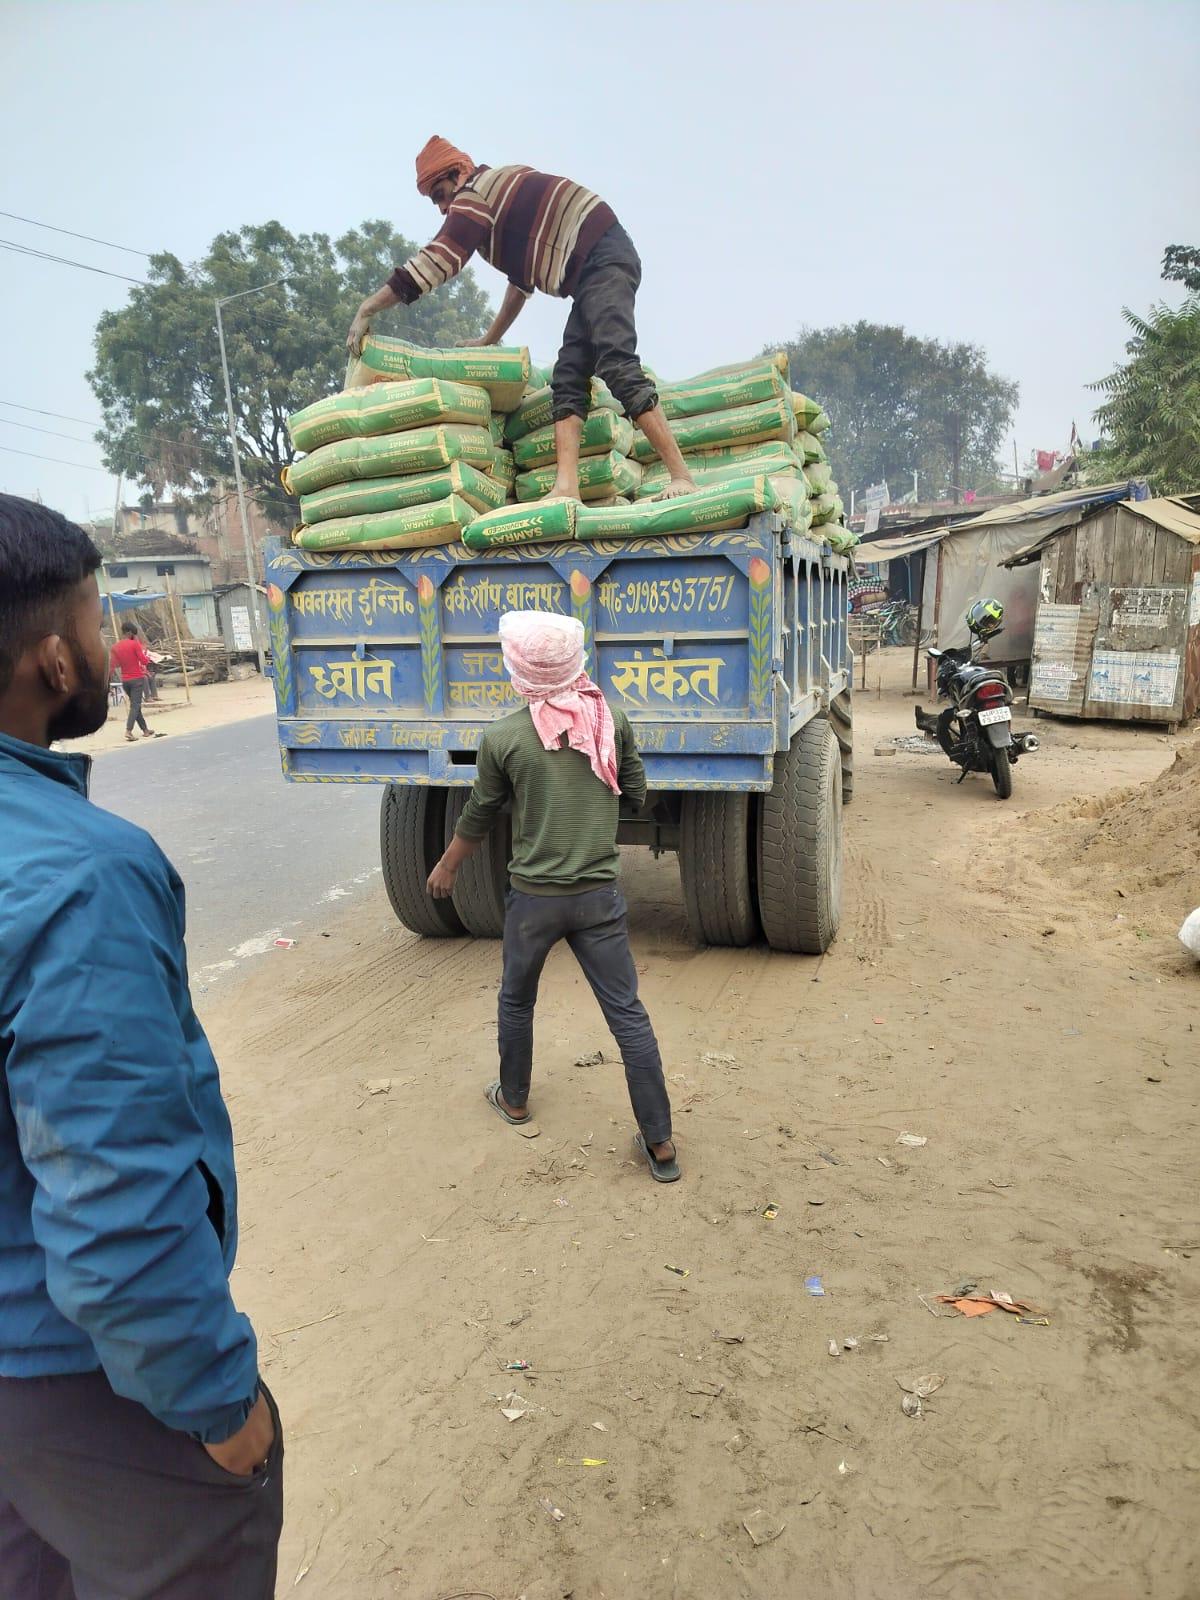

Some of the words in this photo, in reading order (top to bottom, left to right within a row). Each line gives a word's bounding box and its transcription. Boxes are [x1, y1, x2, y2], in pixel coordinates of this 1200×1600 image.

[696, 509, 729, 522] SAMRAT
[403, 518, 434, 531] SAMRAT
[487, 521, 524, 535] ADVANCED
[490, 527, 543, 544] SAMRAT
[611, 648, 726, 706] संकेत
